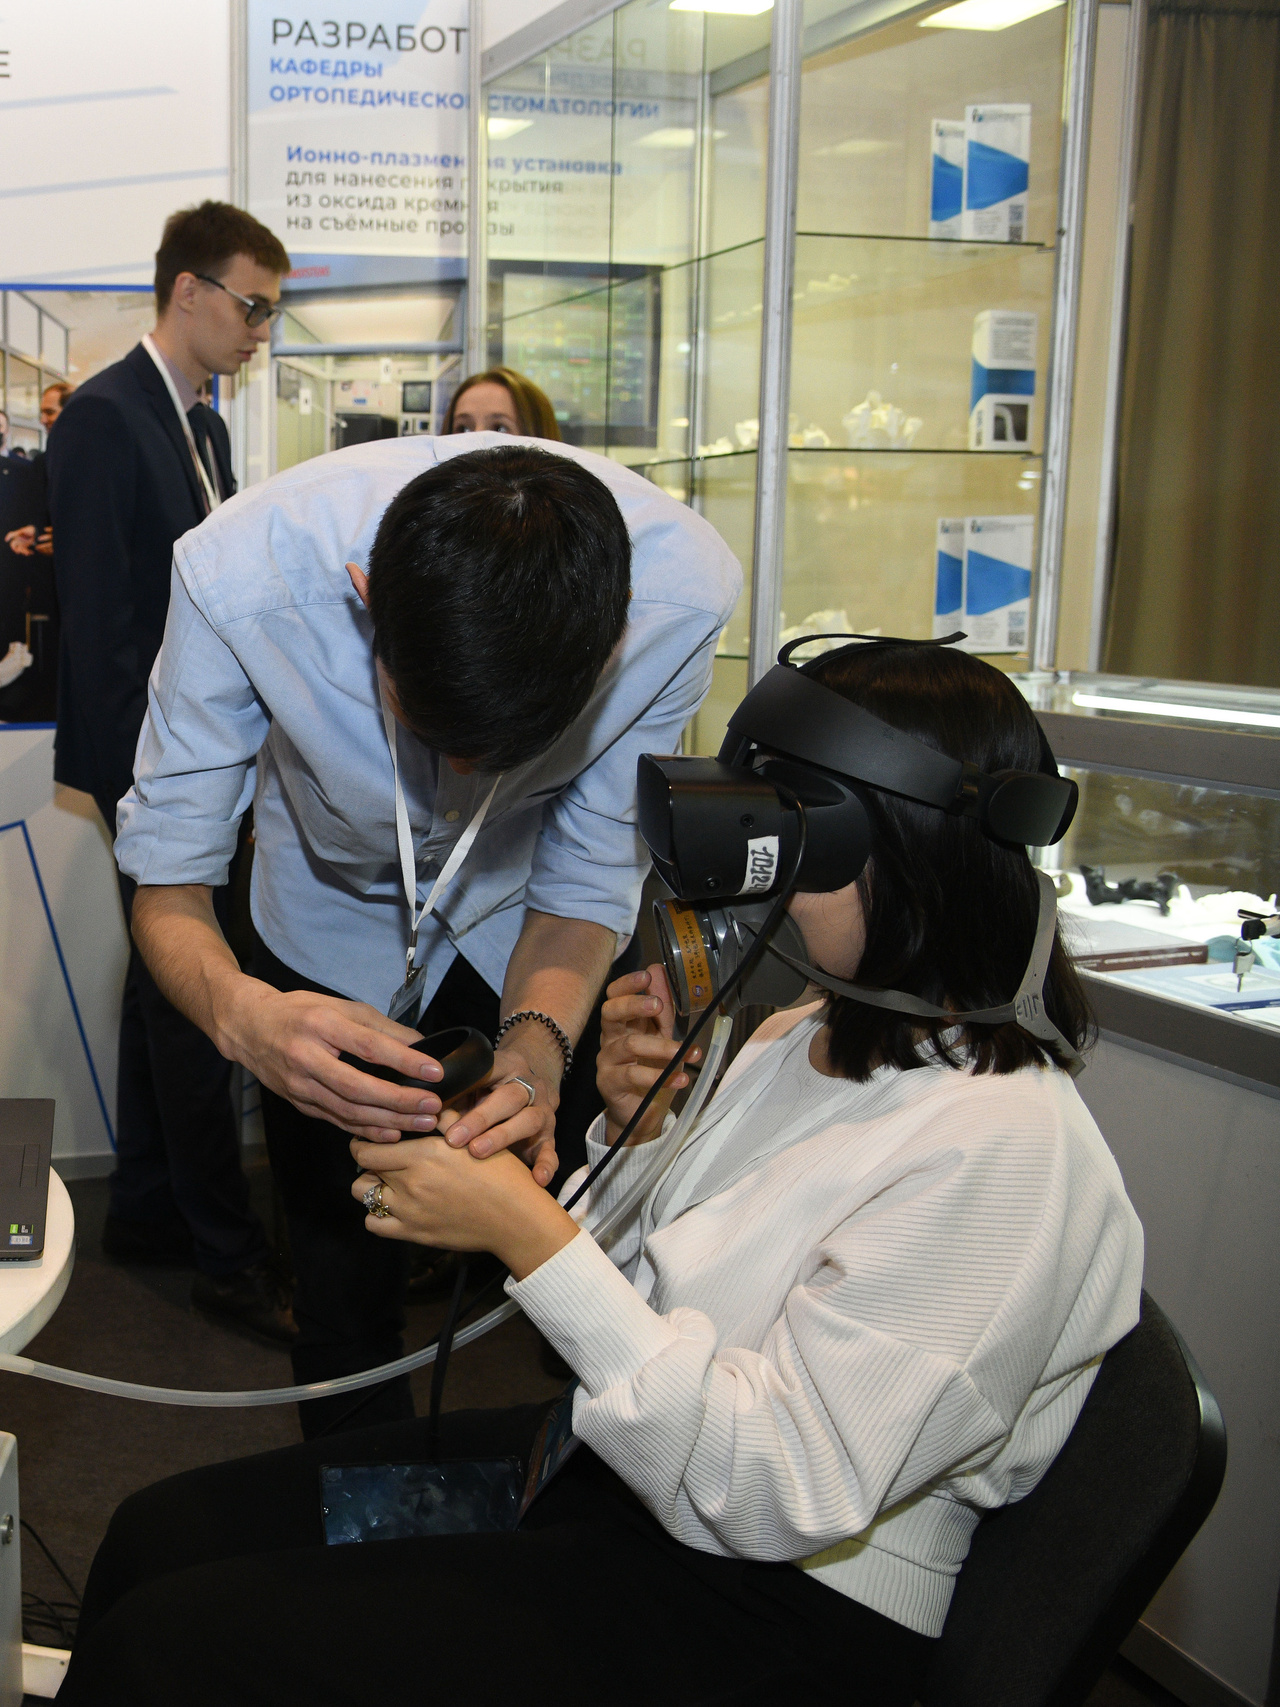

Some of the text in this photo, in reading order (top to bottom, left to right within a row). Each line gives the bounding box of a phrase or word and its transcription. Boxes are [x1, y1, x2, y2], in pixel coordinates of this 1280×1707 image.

[269, 57, 383, 78] КАФЕДРЫ
[269, 85, 660, 119] ОРТОПЕДИЧЕСКО СТОМАТОЛОГИИ
[512, 156, 623, 175] установка
[285, 171, 326, 188] для
[333, 172, 453, 190] нанесения
[286, 193, 312, 208] из
[318, 194, 397, 212] оксида
[286, 215, 313, 231] на
[319, 212, 419, 233] съёмные
